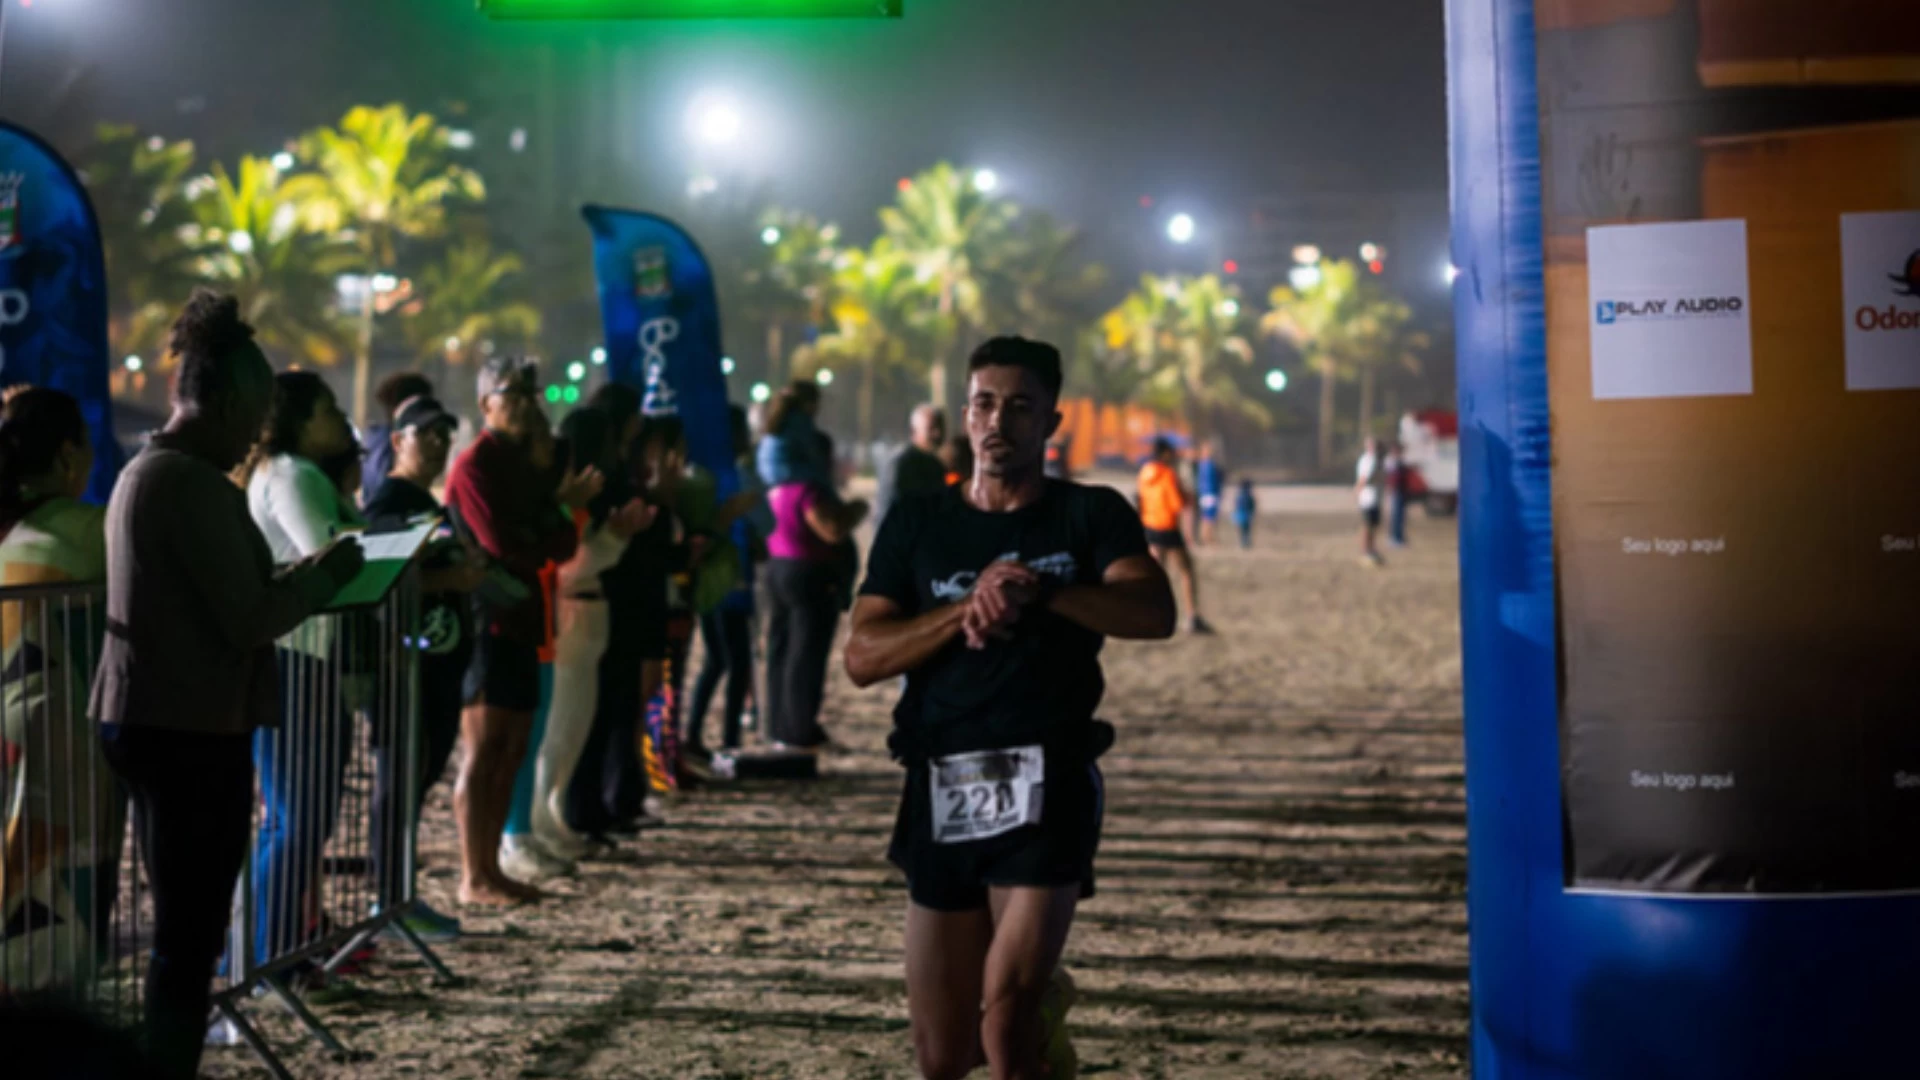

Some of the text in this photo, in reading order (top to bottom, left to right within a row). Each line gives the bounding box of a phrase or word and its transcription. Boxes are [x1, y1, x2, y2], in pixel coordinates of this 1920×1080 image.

[1616, 296, 1742, 315] PLAY AUDIO
[1621, 534, 1726, 556] Seu logo aqui
[1629, 769, 1735, 792] Seu logo aqui
